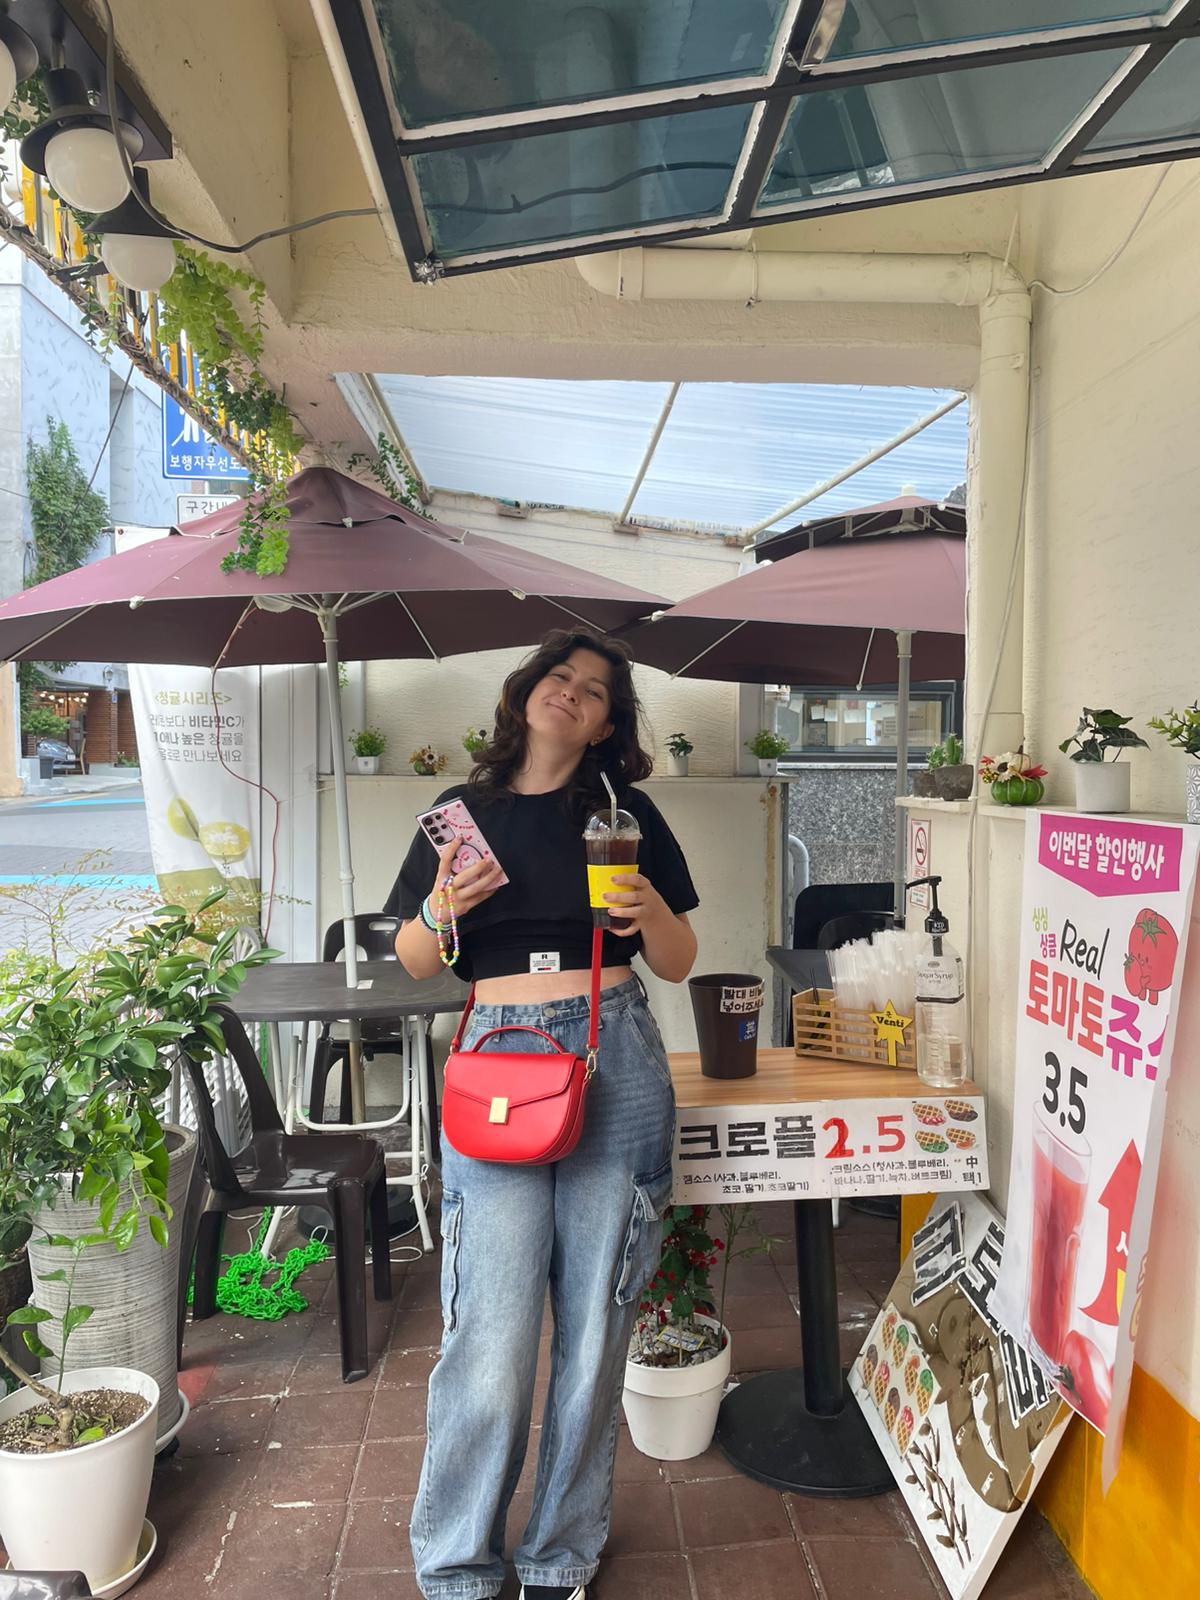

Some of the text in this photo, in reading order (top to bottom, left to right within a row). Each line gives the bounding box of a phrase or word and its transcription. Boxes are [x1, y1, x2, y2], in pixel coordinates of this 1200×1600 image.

[182, 732, 206, 746] 높은
[1049, 831, 1165, 881] 이번달 할인행사
[1032, 906, 1048, 932] 싱싱
[1040, 933, 1057, 959] 상큼
[1060, 918, 1111, 980] Real
[876, 1015, 905, 1029] Venti
[1042, 1051, 1088, 1134] 3.5
[679, 1114, 906, 1160] 크로플 2.5
[965, 1155, 979, 1169] 中
